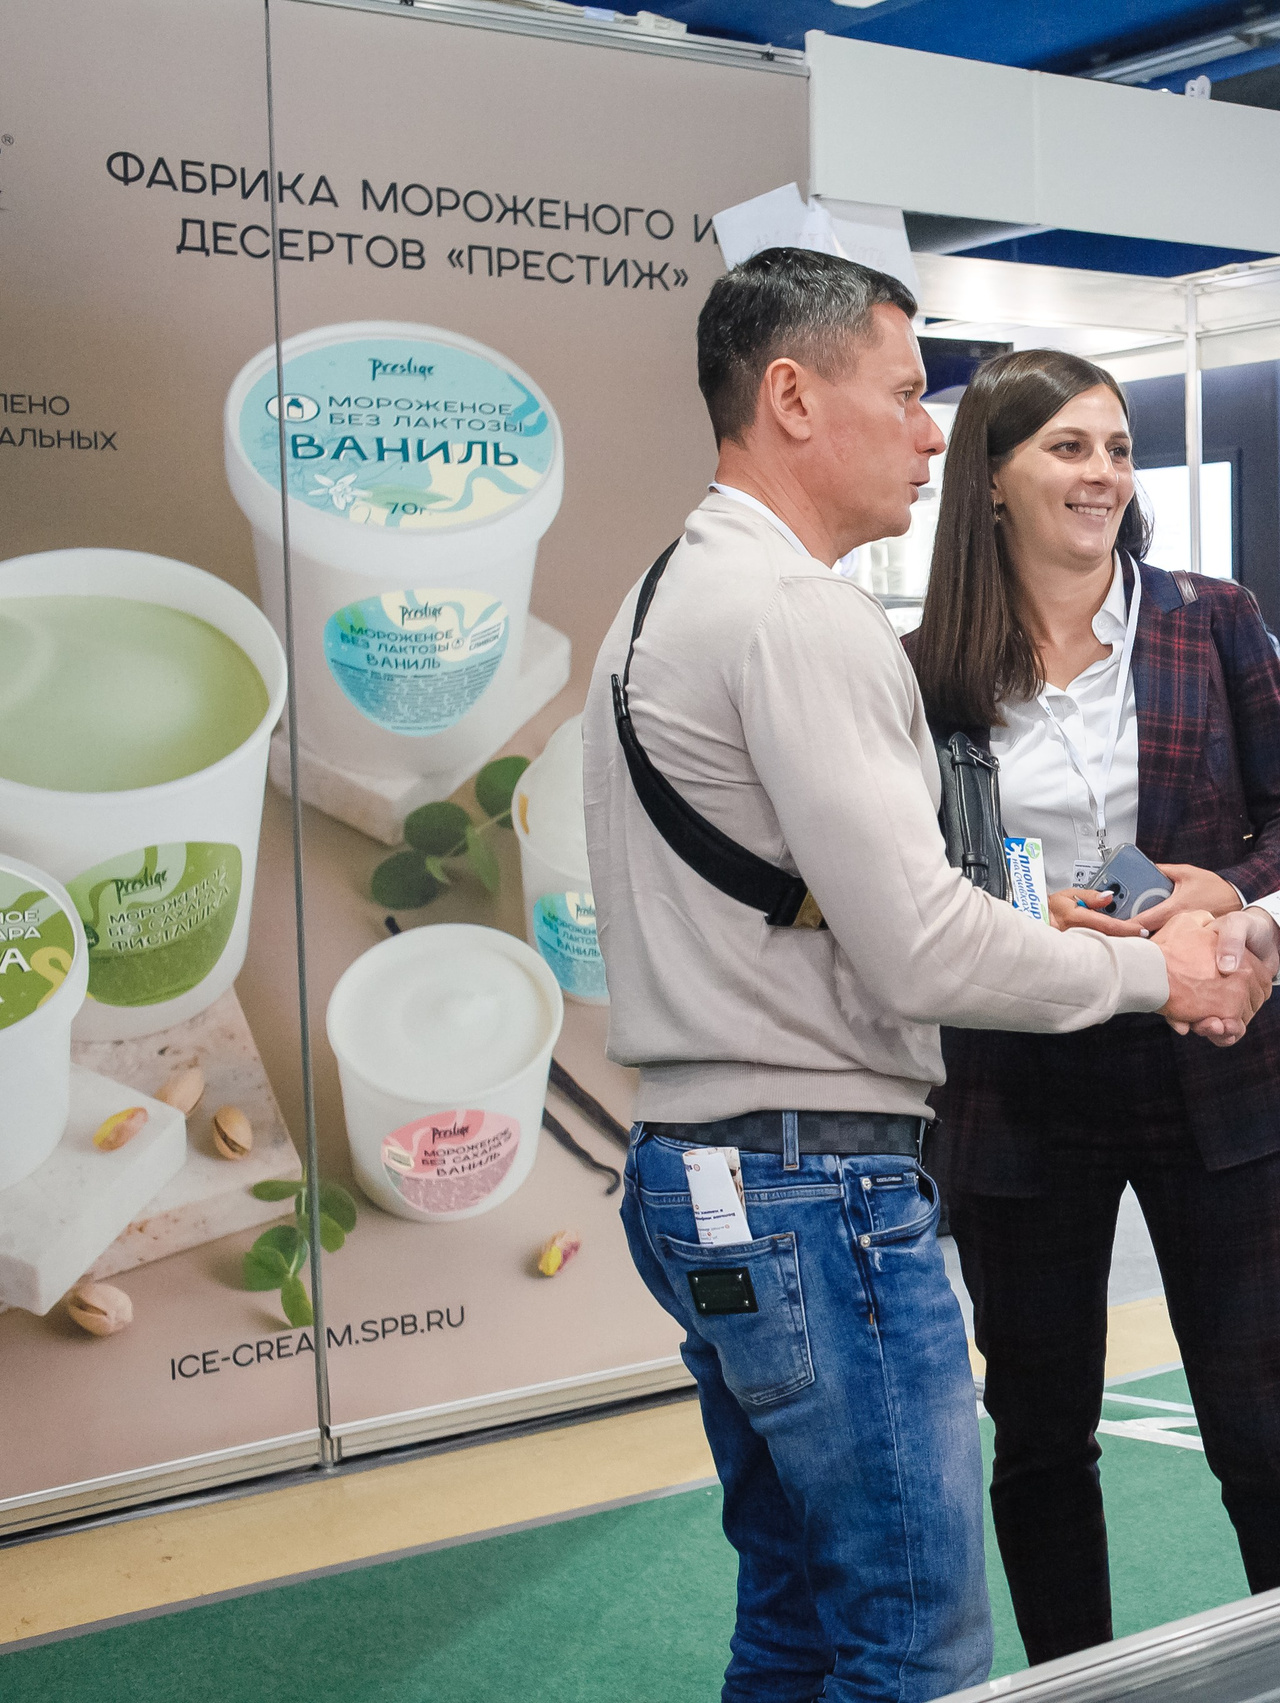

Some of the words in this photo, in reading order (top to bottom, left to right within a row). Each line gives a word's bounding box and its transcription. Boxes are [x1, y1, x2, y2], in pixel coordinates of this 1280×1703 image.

[106, 151, 339, 208] ФАБРИКА
[362, 179, 674, 240] МОРОЖЕНОГО
[694, 213, 718, 245] И
[176, 218, 426, 271] ДЕСЕРТОВ
[447, 244, 689, 291] «ПРЕСТИЖ»
[328, 395, 512, 416] МОРОЖЕНОЕ
[329, 412, 380, 426] БЕЗ
[393, 414, 524, 433] ЛАКТОЗЫ
[0, 427, 117, 451] АЛЬНЫХ
[290, 433, 519, 467] ВАНИЛЬ
[350, 625, 454, 643] МОРОЖЕНОЕ
[378, 642, 449, 653] ЛАКТОЗЫ
[366, 653, 441, 671] ВАНИЛЬ
[1018, 853, 1042, 920] пломбир
[170, 1305, 465, 1381] ICE-CREAM.SPB.RU
